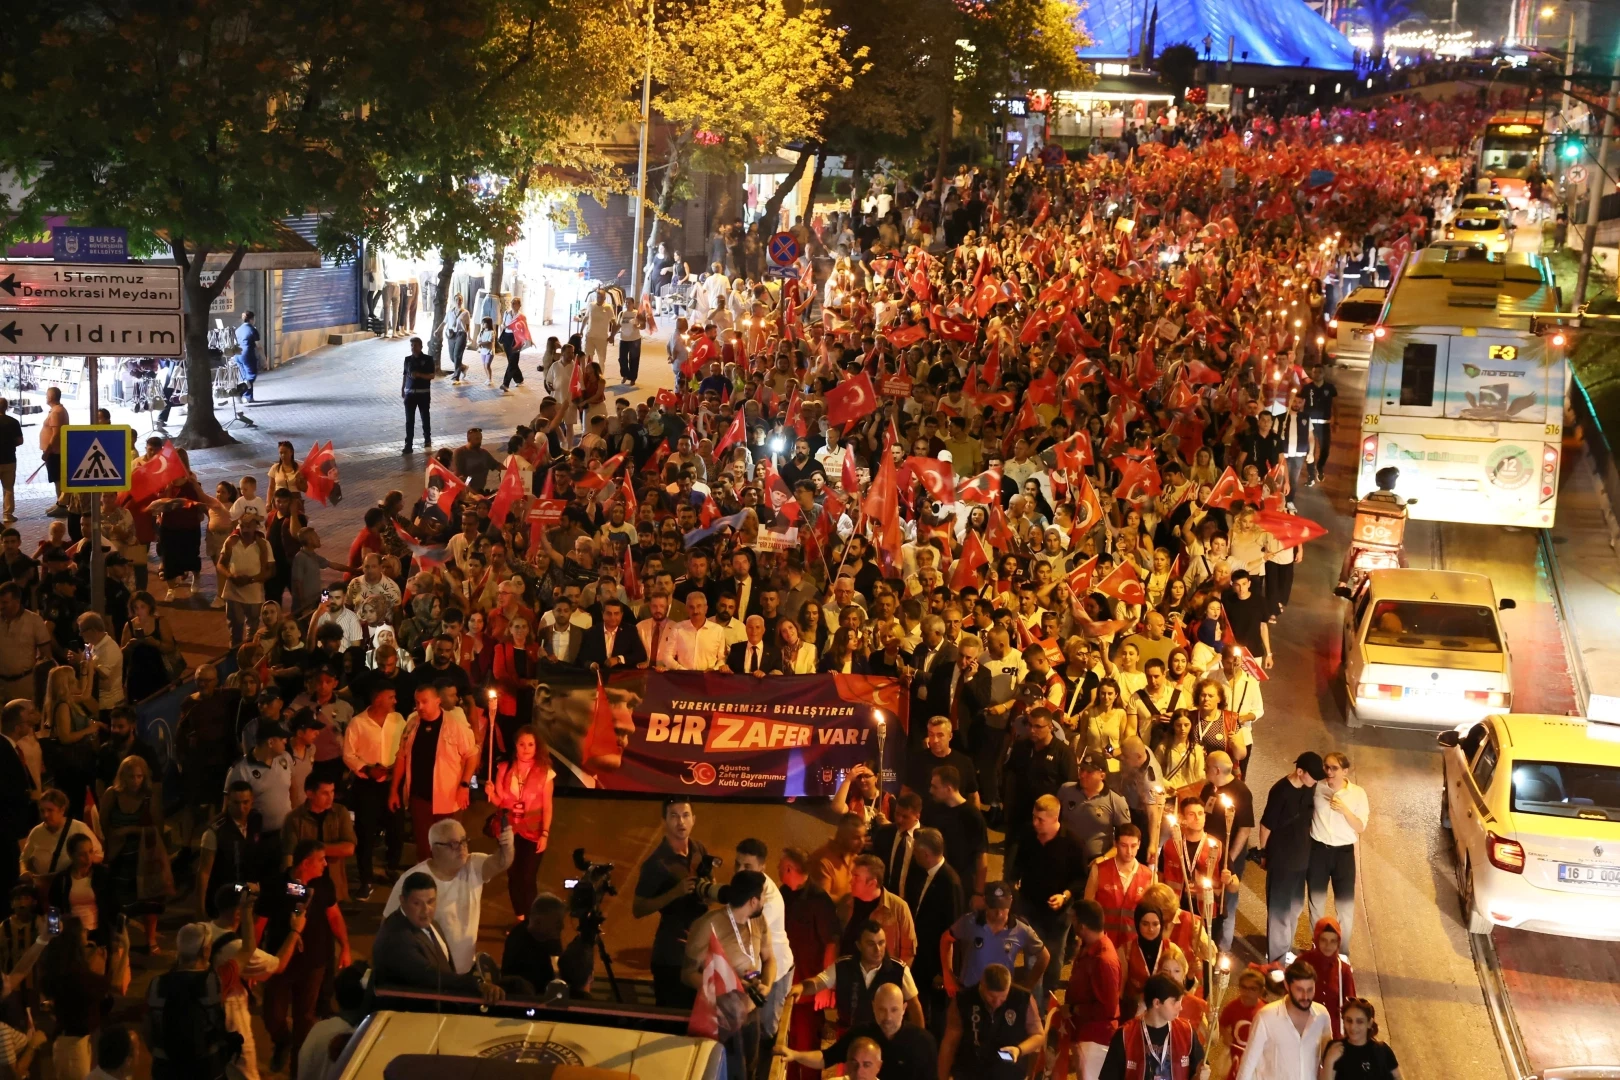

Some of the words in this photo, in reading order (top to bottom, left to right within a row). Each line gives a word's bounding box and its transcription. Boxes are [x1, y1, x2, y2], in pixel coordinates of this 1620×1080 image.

[53, 271, 73, 283] 15
[77, 272, 144, 284] Temmuz
[23, 286, 104, 298] Demokrasi
[109, 288, 172, 302] Meydanı
[40, 324, 175, 344] Yıldırım
[1364, 414, 1379, 425] 516
[1545, 424, 1560, 435] 516
[1503, 458, 1517, 471] 12
[671, 700, 768, 713] YÜREKLERİMİZİ
[773, 704, 854, 718] BİRLEŞTİREN
[646, 712, 706, 746] BİR
[710, 717, 811, 748] ZAFER
[718, 764, 750, 772] Ağustos
[740, 772, 786, 781] Bayramımız
[718, 779, 739, 787] Kutlu
[740, 780, 767, 788] Olsun!
[1567, 867, 1580, 879] 16
[1586, 869, 1594, 880] D
